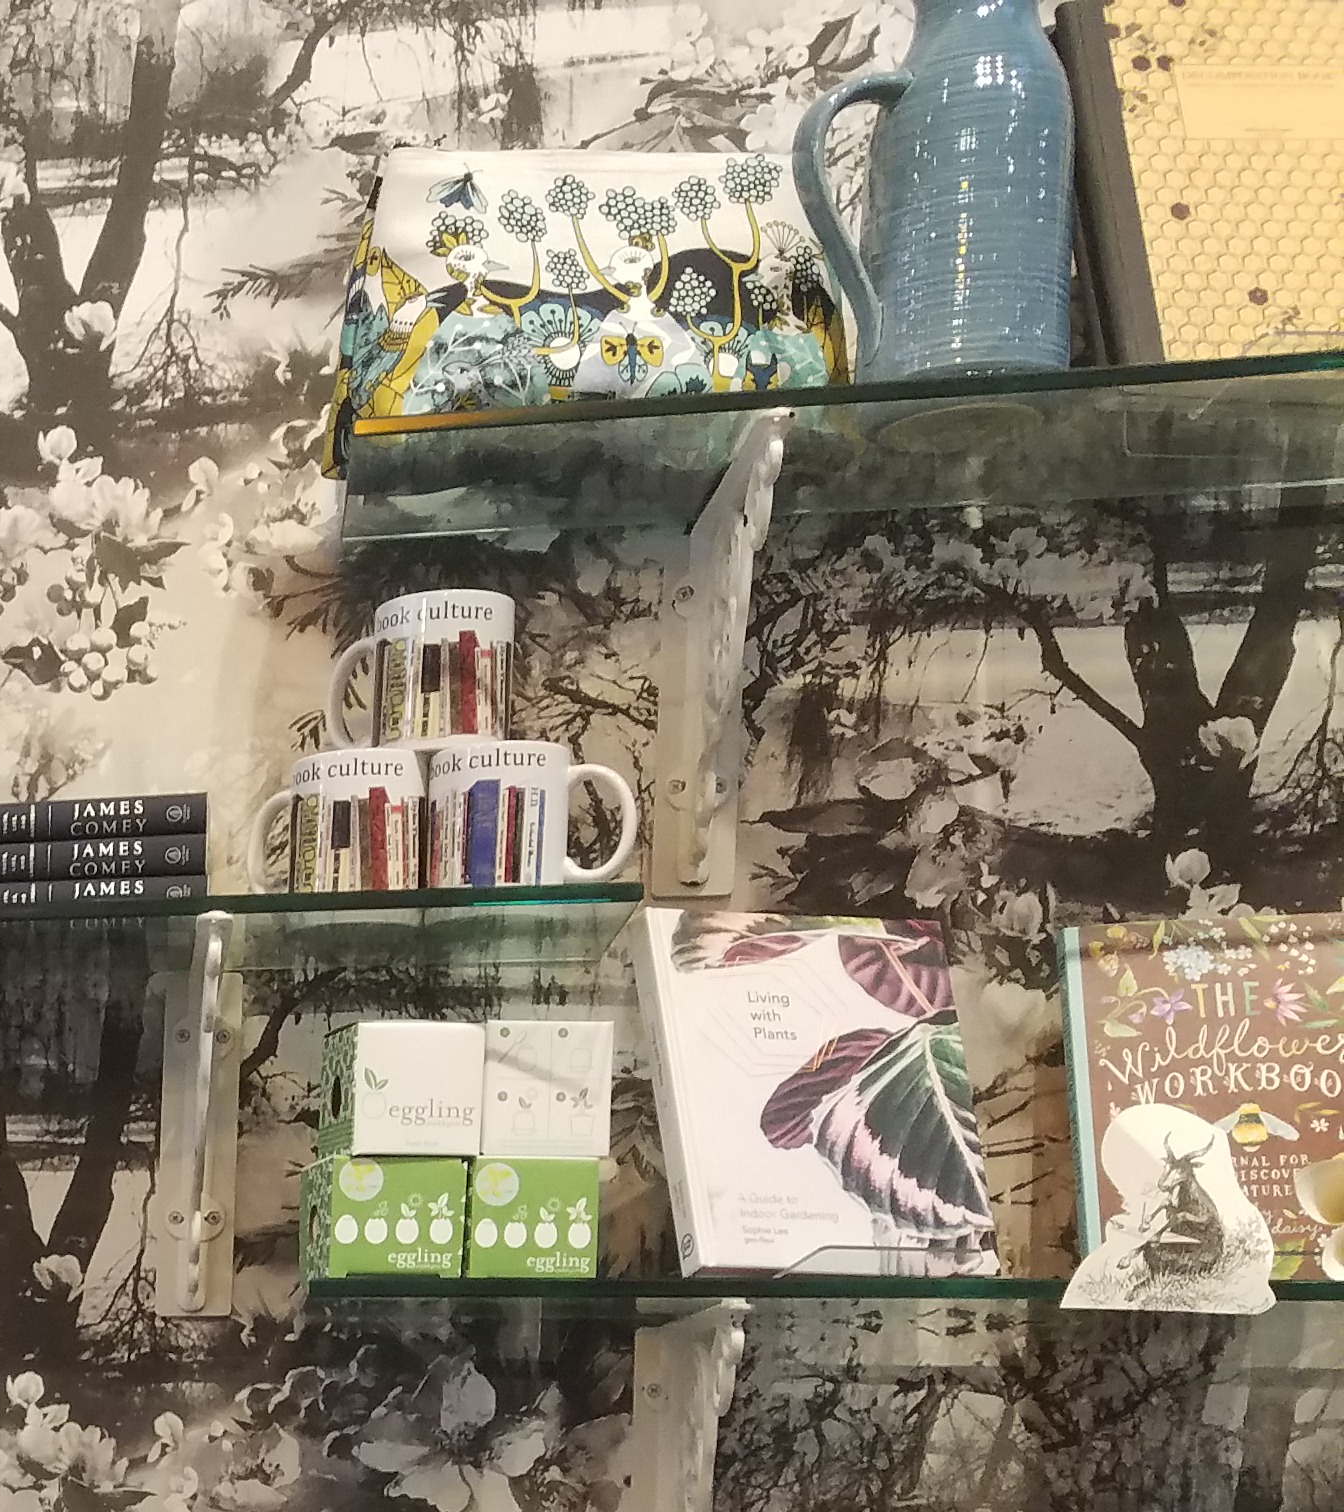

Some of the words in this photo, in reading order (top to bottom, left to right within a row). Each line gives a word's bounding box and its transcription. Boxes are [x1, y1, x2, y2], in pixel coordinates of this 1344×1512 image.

[417, 600, 493, 622] culture
[469, 745, 547, 769] culture
[293, 763, 322, 784] ook
[327, 757, 404, 778] culture
[73, 800, 145, 818] JAMES
[71, 818, 148, 836] COMEY
[72, 841, 143, 860] JAMES
[69, 860, 146, 876] COMEY
[74, 881, 145, 899] JAMES
[747, 991, 790, 1007] Living
[1191, 981, 1261, 1019] THE
[750, 1009, 781, 1022] with
[753, 1026, 797, 1041] Plants
[1134, 1061, 1343, 1104] WORKBOO
[388, 1099, 475, 1127] eggling
[1279, 1154, 1312, 1166] FOR
[1242, 1184, 1293, 1197] ATURE
[388, 1247, 453, 1269] eggling
[527, 1251, 591, 1274] eggling
